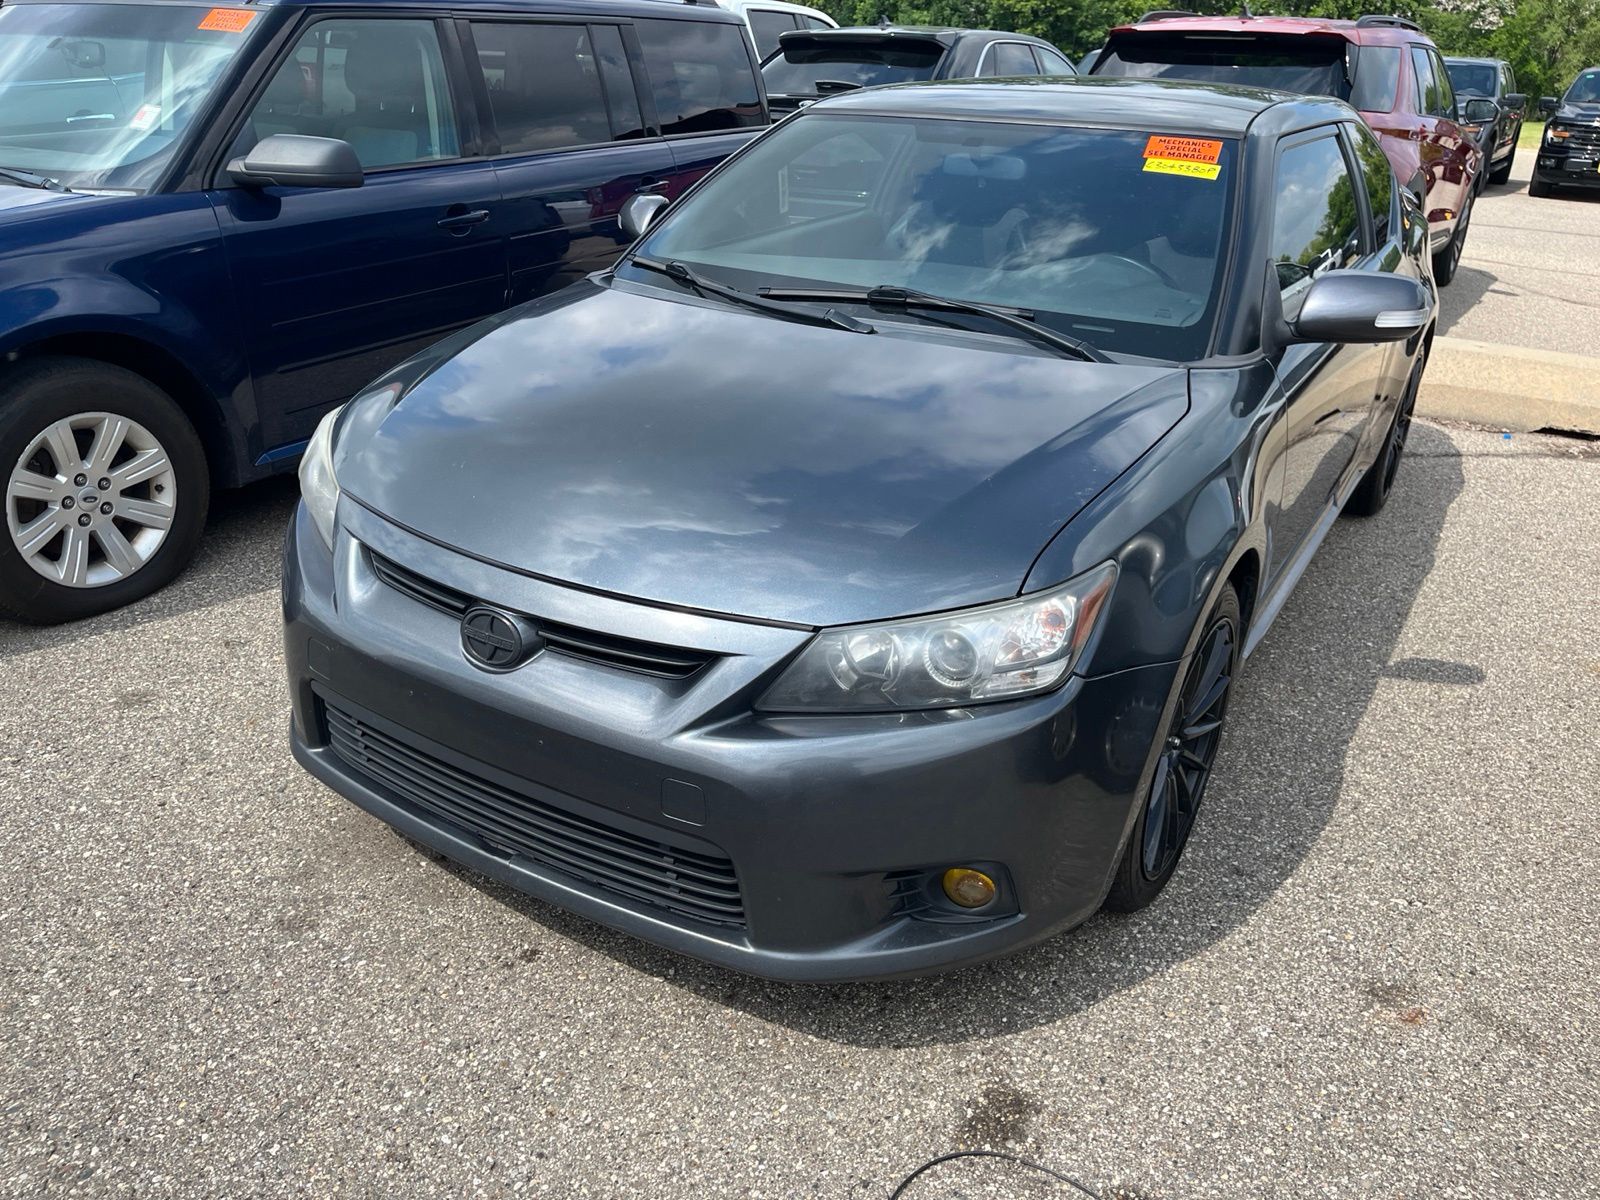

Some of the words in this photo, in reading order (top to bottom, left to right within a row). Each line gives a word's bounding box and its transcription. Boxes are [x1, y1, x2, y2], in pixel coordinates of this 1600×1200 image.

[1158, 138, 1212, 148] MECHANICS
[1164, 145, 1202, 153] SPECIAL
[1167, 151, 1215, 161] MANAGER
